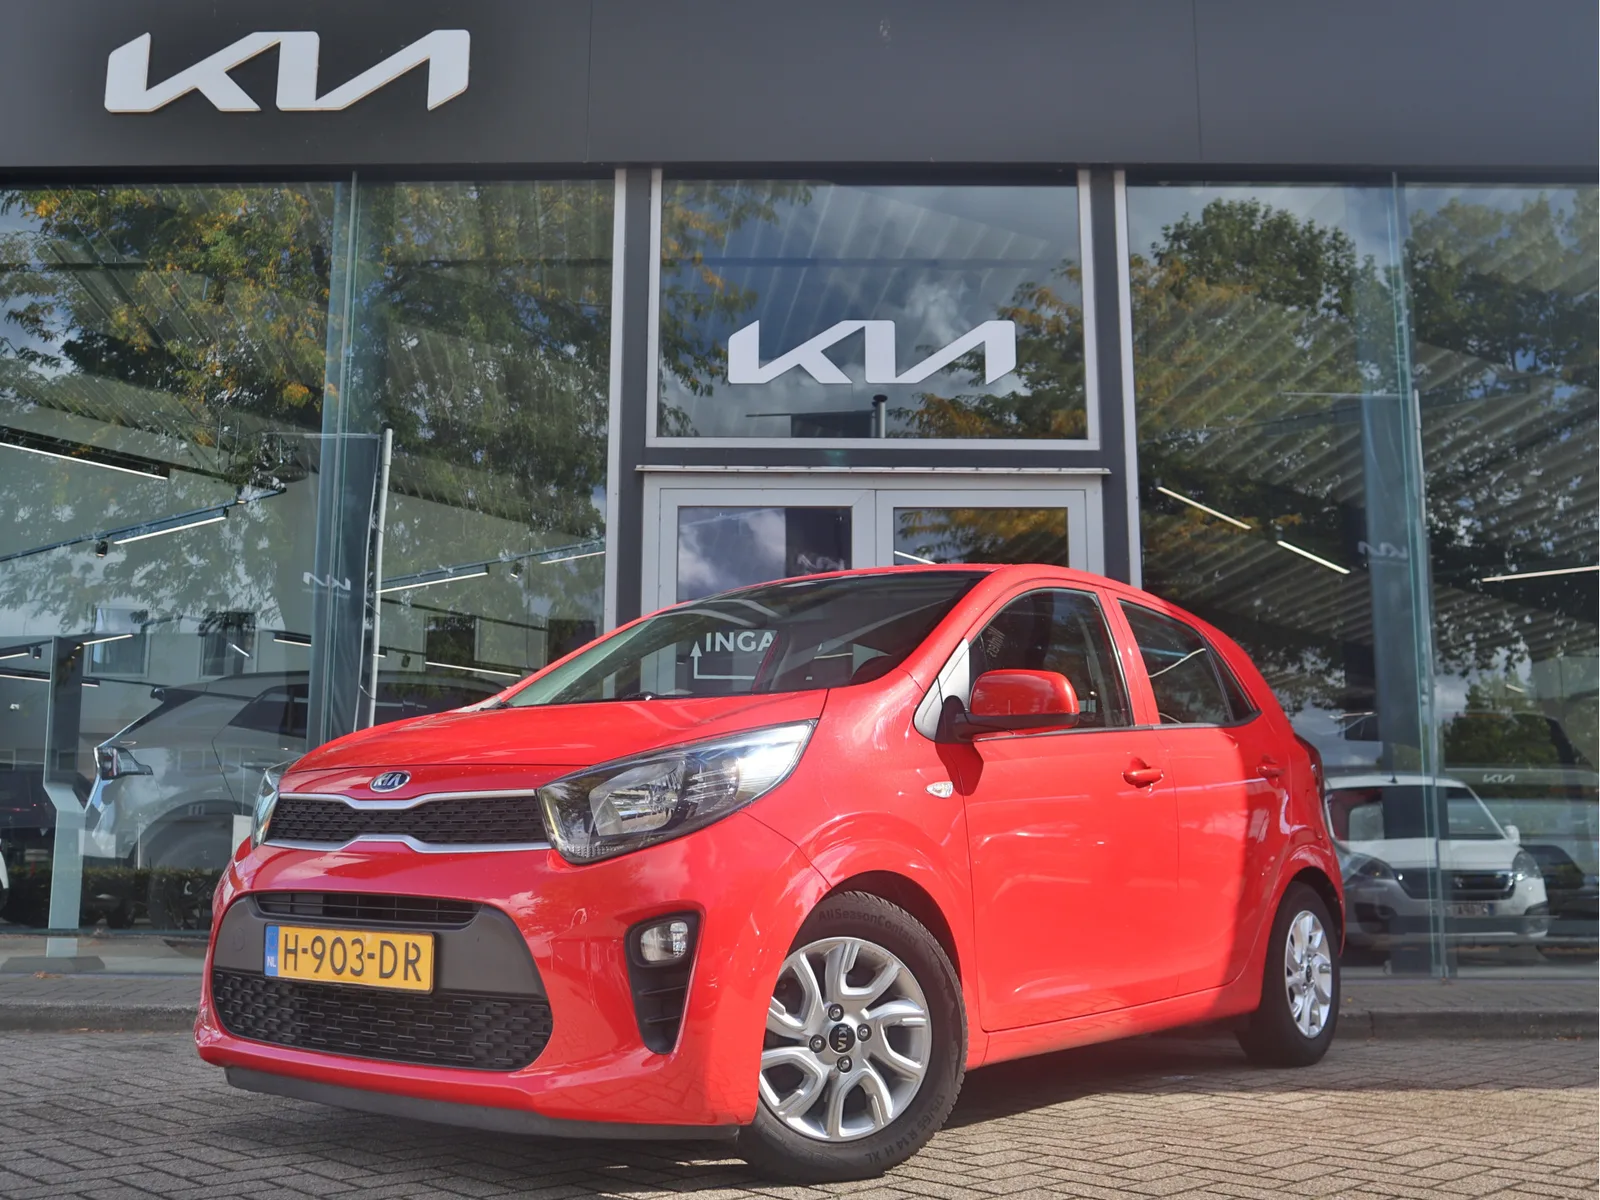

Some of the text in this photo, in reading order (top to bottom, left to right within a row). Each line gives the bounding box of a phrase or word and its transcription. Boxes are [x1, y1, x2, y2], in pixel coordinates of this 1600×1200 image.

[104, 29, 470, 112] KIA
[728, 320, 1017, 385] KIA
[373, 773, 402, 787] KIA
[266, 934, 421, 982] NL H-903-DR
[838, 1026, 848, 1051] KIA
